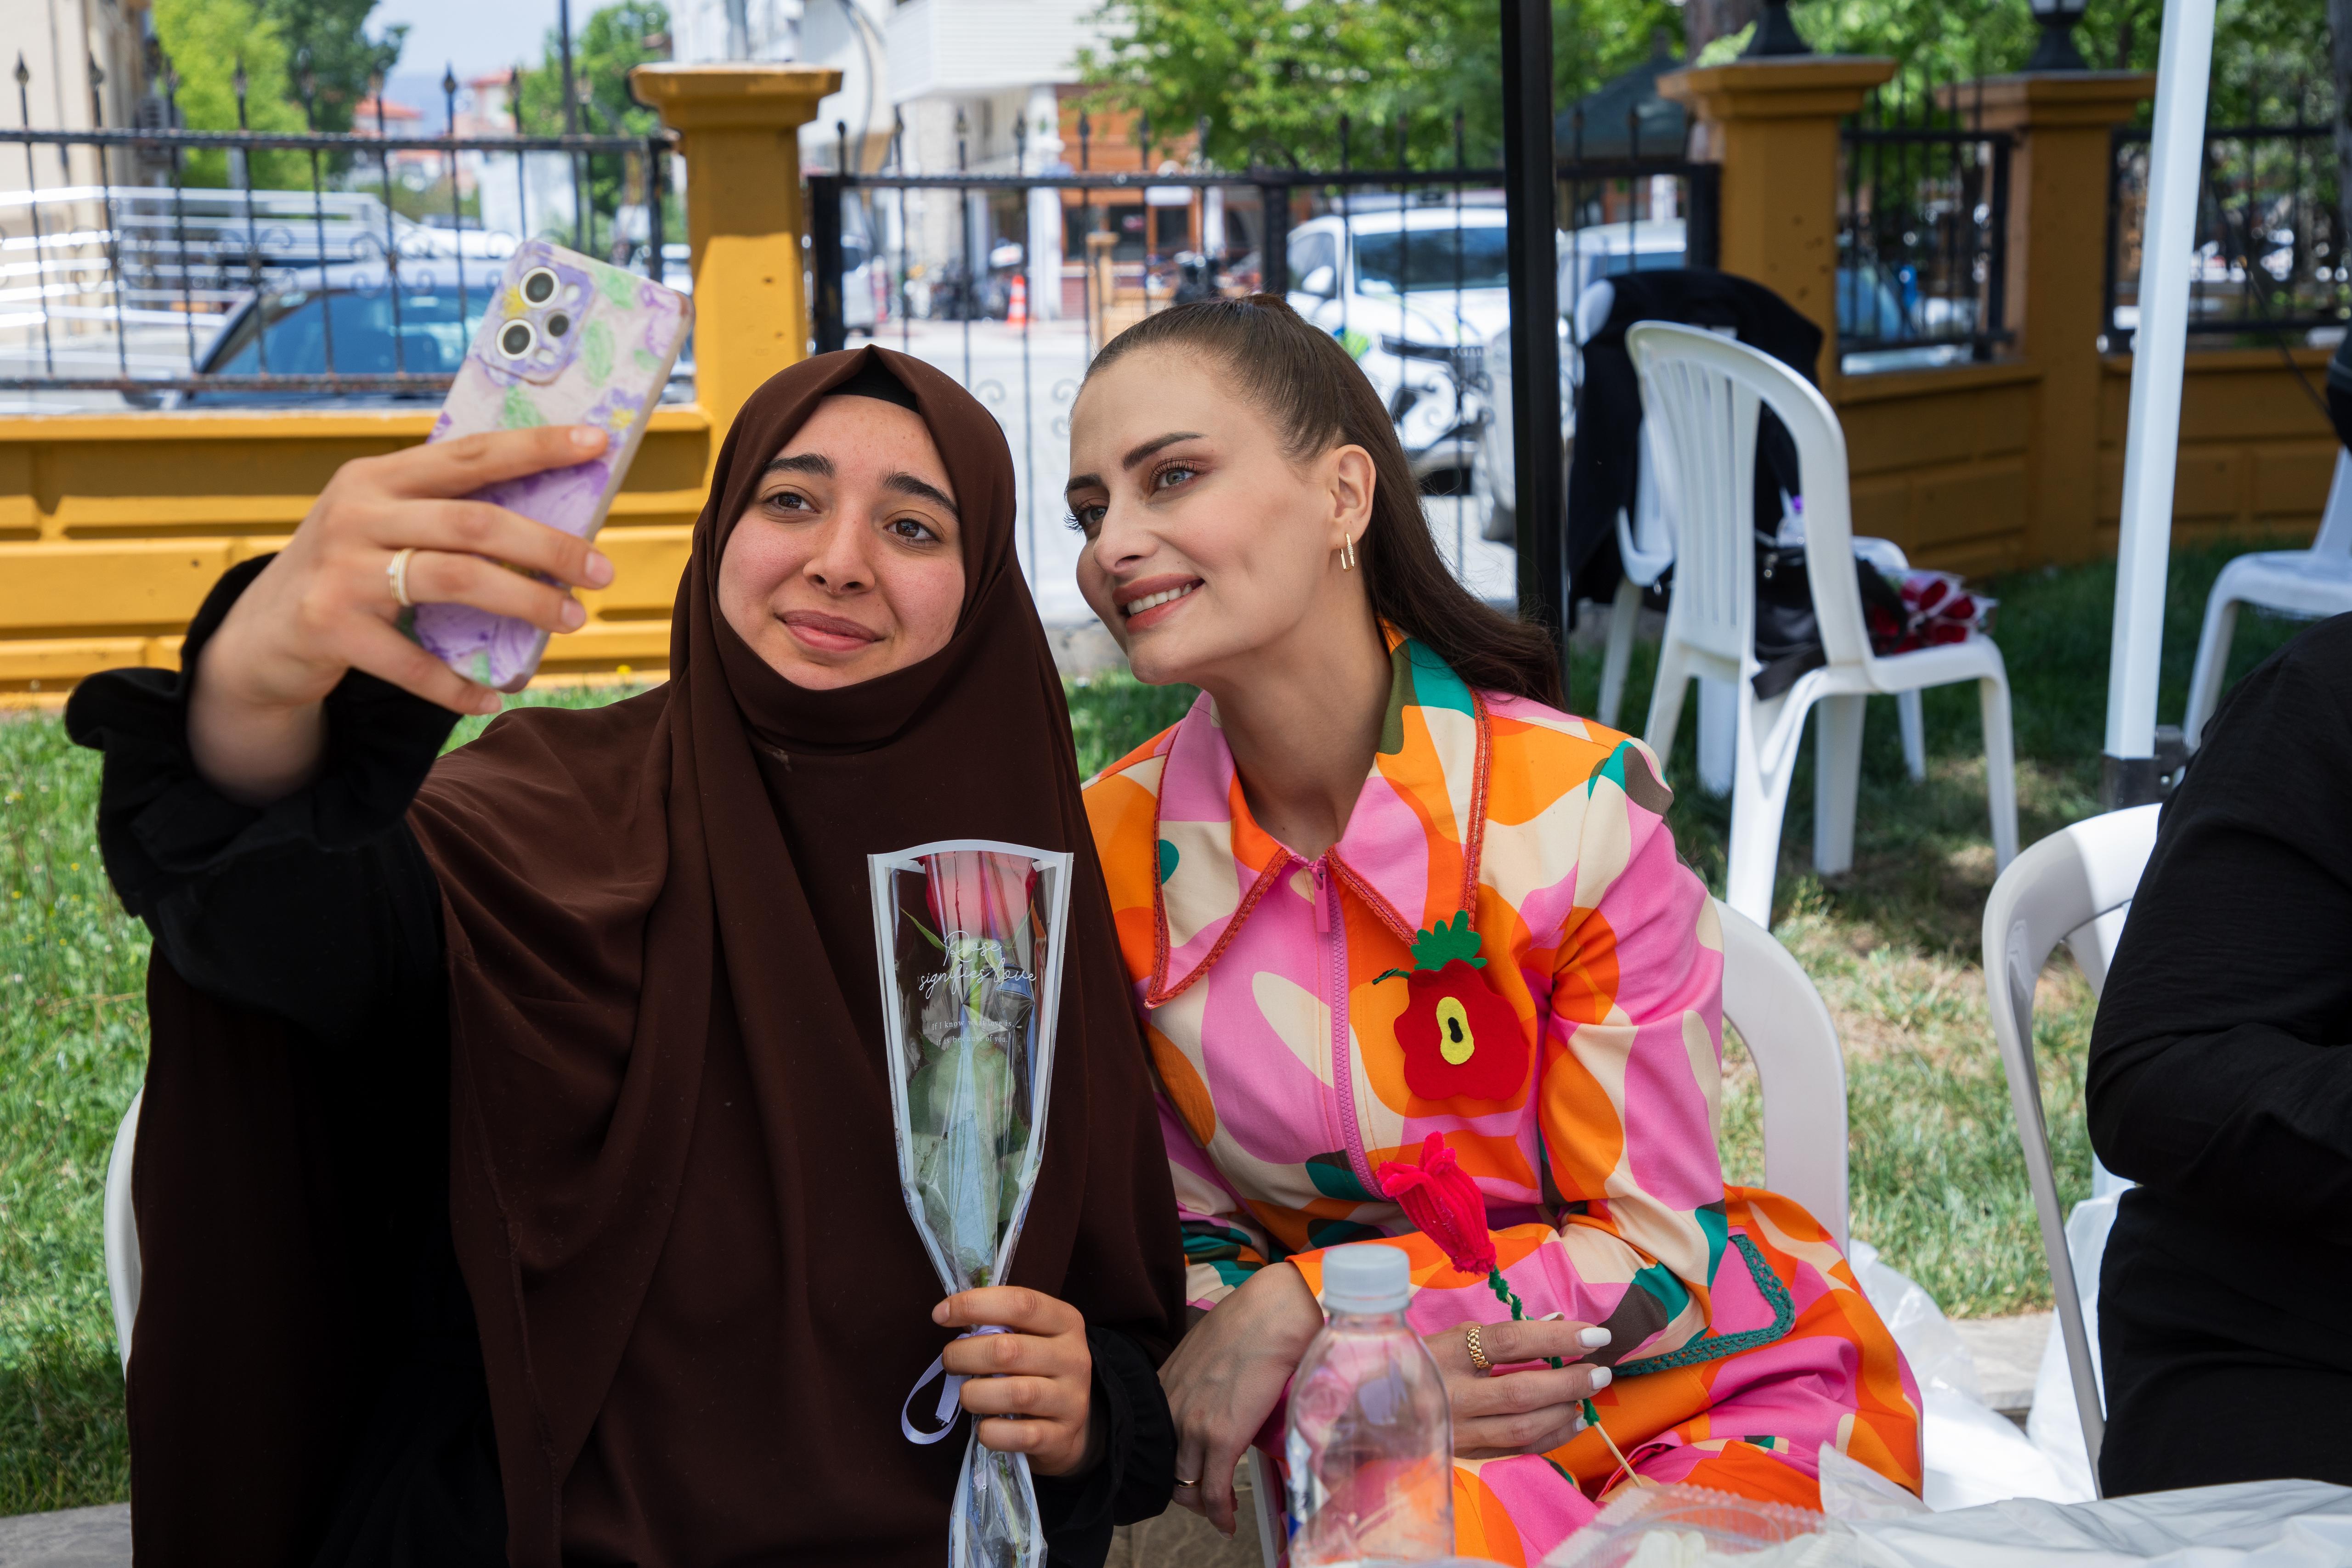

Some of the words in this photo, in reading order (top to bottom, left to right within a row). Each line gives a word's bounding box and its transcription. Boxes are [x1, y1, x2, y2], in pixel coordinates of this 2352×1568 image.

[943, 931, 1002, 966] Rose
[919, 964, 989, 999] signifies
[994, 958, 1037, 983] love
